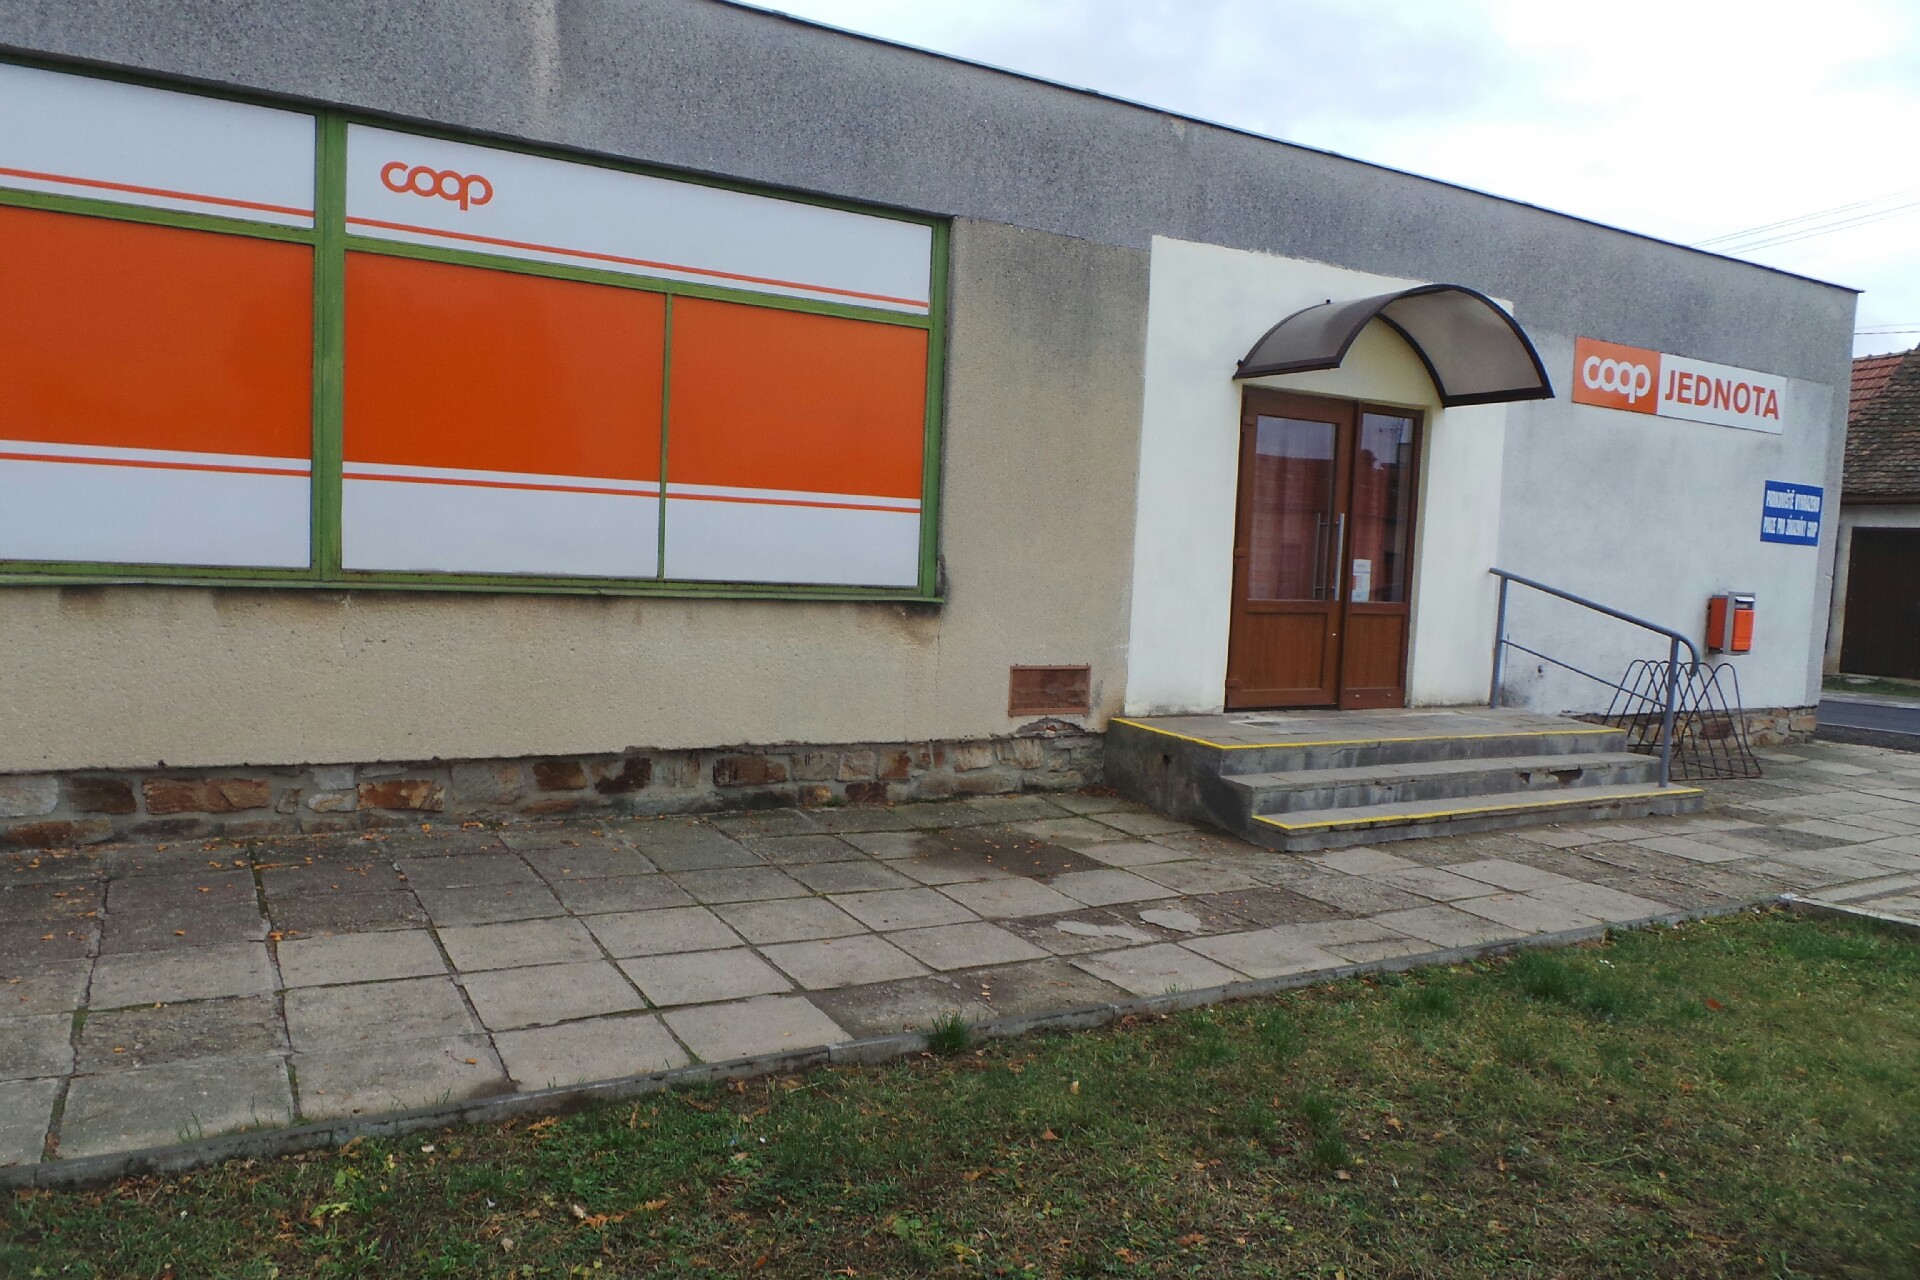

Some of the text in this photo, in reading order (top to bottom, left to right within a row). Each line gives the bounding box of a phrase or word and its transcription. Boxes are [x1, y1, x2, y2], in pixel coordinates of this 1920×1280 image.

[380, 161, 494, 212] coop
[1582, 355, 1780, 420] coop JEDNOTA
